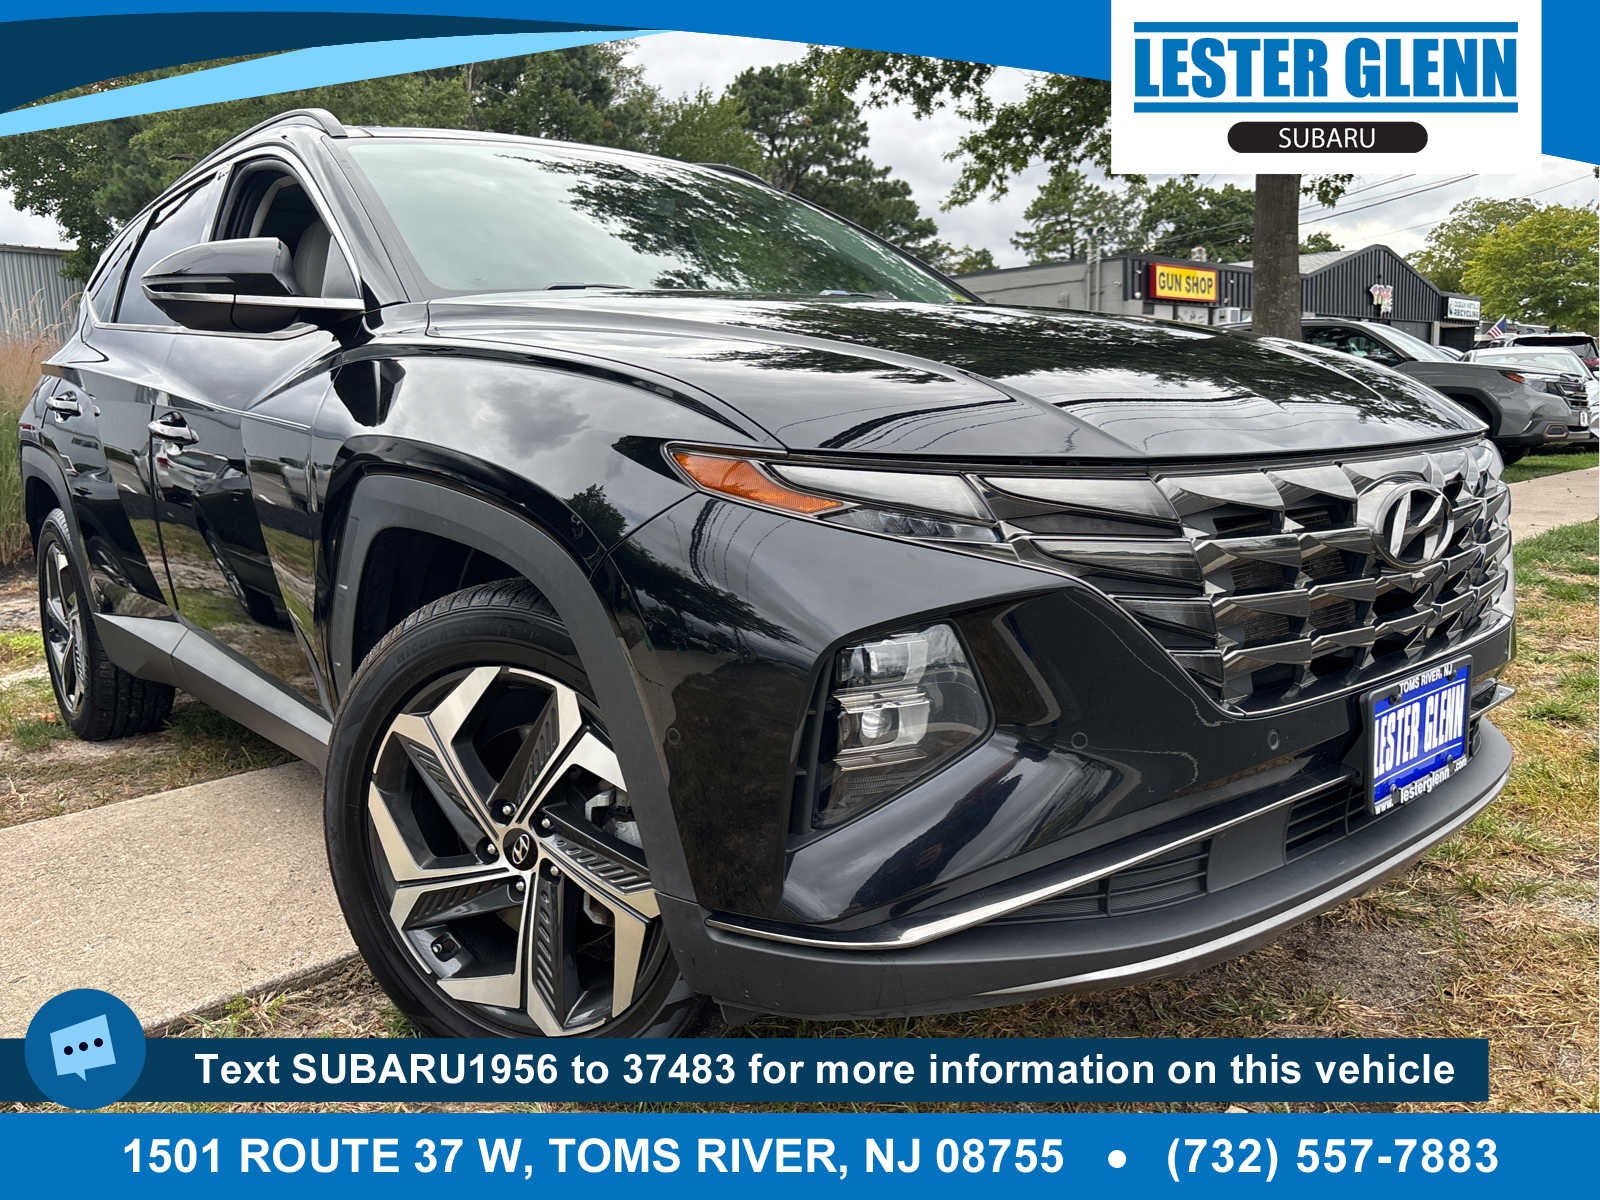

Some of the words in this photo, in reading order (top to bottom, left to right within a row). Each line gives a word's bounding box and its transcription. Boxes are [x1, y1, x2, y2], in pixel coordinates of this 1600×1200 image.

[1158, 272, 1182, 292] GUN
[1185, 275, 1213, 294] SHOP
[1399, 676, 1420, 695] TOMS
[1443, 662, 1453, 678] NJ
[1374, 701, 1420, 779] LESTER
[1422, 683, 1465, 753] GLENN
